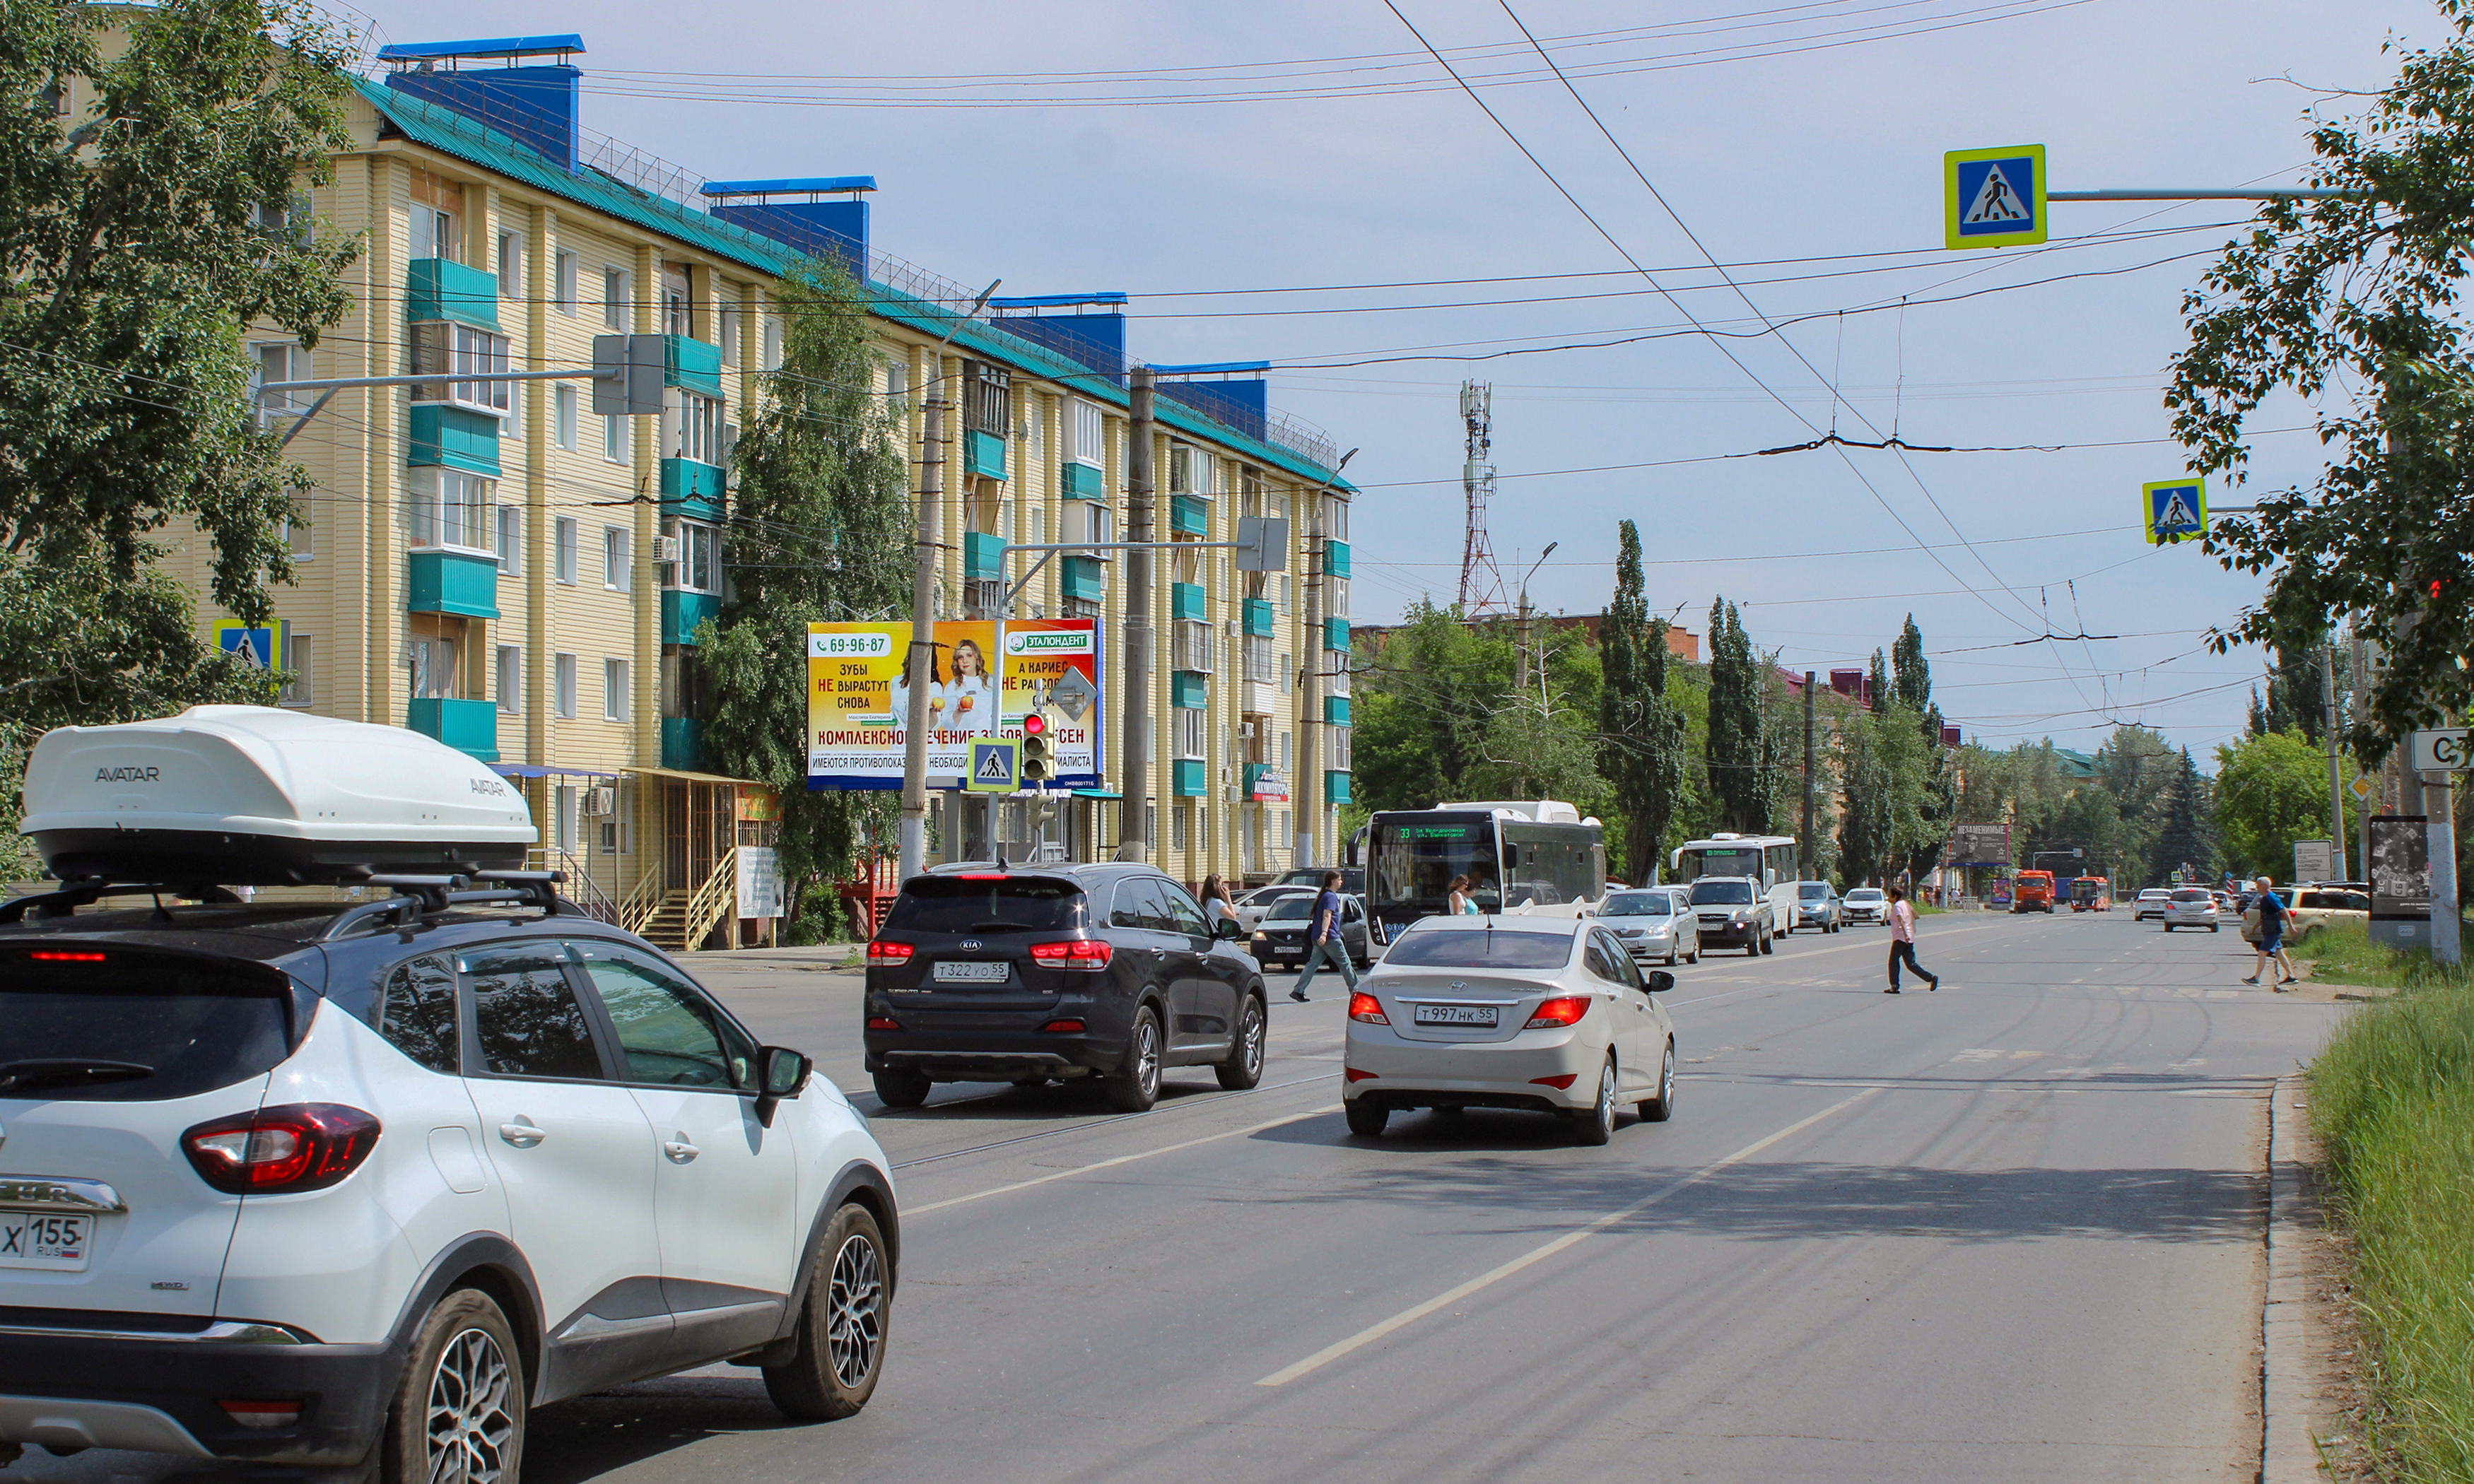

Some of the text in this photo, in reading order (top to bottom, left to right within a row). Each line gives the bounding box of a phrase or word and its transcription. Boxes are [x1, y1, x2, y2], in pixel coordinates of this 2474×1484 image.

[830, 638, 884, 652] 69-96-87
[1028, 636, 1085, 646] ЭТАЛОНДЕНТ
[840, 664, 867, 676] ЗУБЫ
[1019, 661, 1068, 673] А КАРИЕС
[819, 678, 889, 692] НЕ ВЫРАСТУТ
[1002, 676, 1017, 690] НЕ
[838, 697, 870, 709] СНОВА
[927, 730, 975, 744] ЕЧЕНИЕ
[813, 758, 848, 768] ИМЕЮТСЯ
[850, 757, 905, 768] ПРОТИВОПОКАЗ
[929, 758, 968, 769] НЕОБХОДИ
[95, 767, 160, 782] AVATAR
[470, 778, 507, 797] AVATAR
[1400, 828, 1410, 839] 33
[992, 964, 1004, 974] 55
[1479, 1008, 1494, 1019] 55
[30, 1218, 79, 1246] 155
[37, 1246, 61, 1256] RUS
